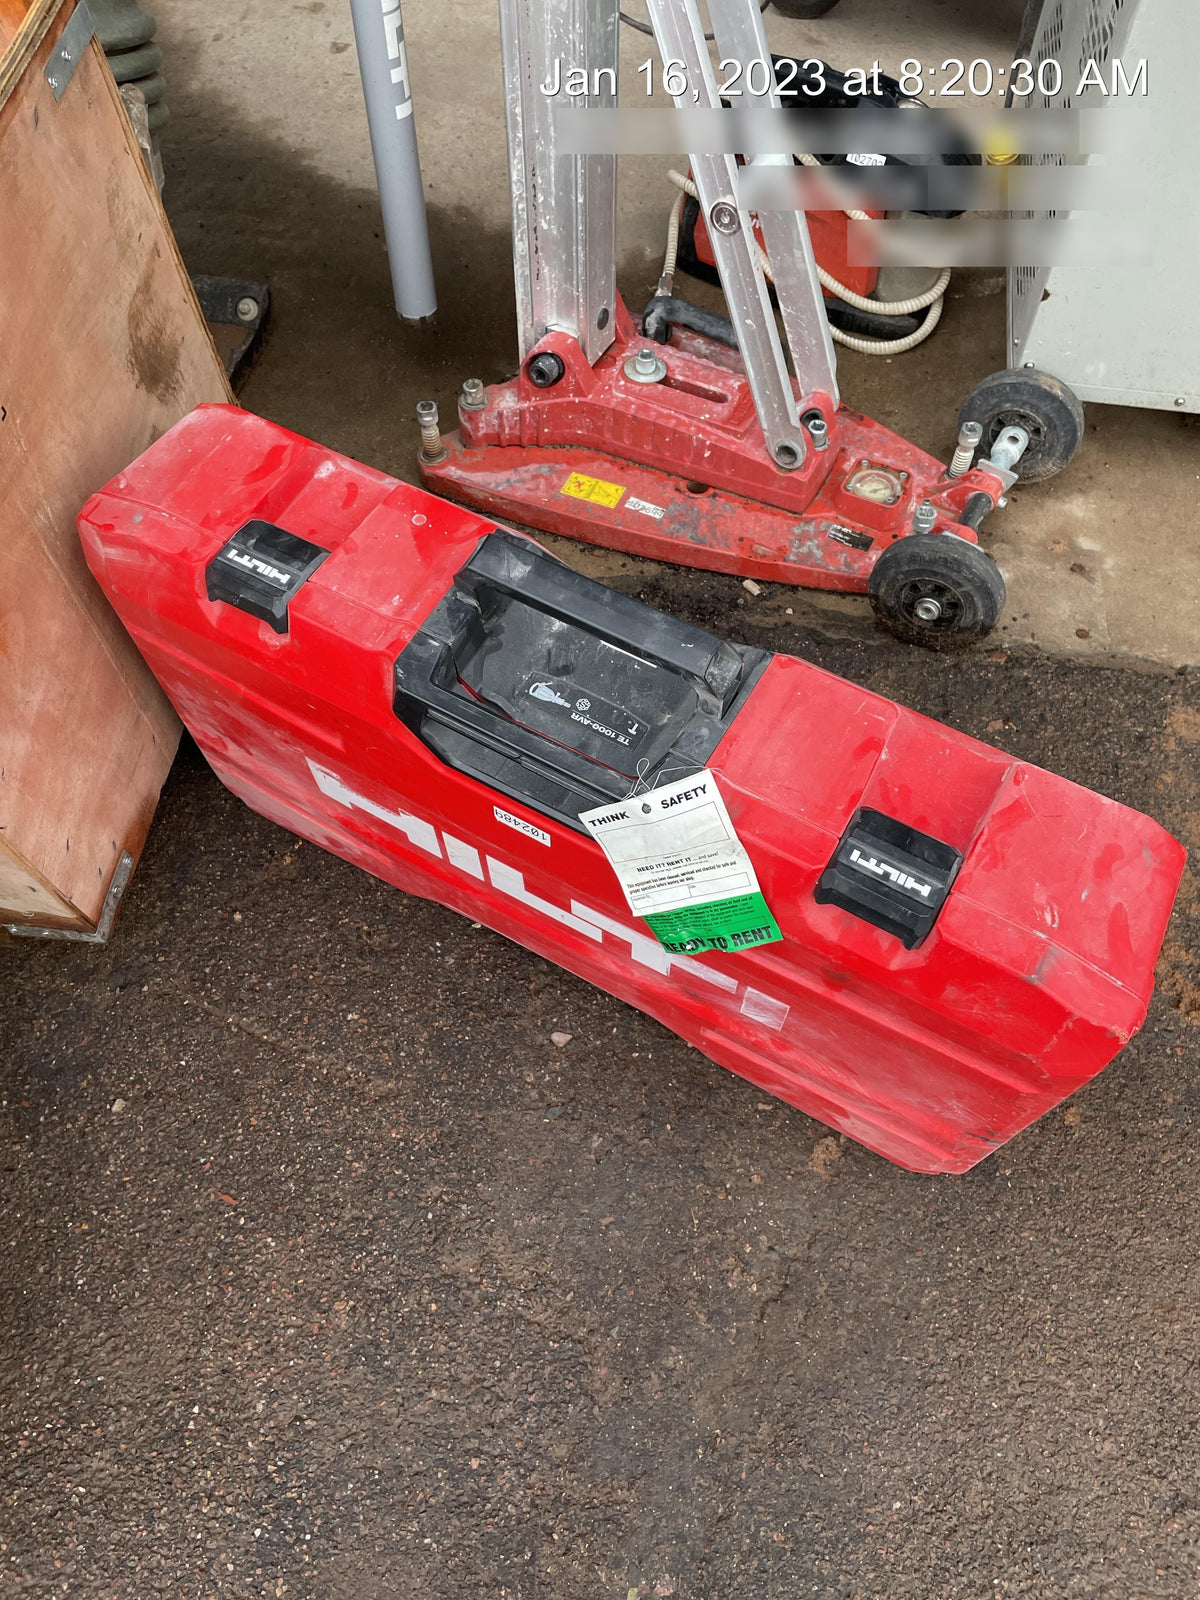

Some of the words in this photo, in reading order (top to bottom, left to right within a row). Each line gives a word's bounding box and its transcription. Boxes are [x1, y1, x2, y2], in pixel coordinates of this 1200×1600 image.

[227, 549, 291, 584] HILTI
[570, 712, 616, 739] 1000-AVR
[616, 734, 630, 746] TE
[588, 811, 630, 827] THINK
[660, 784, 707, 809] SAFETY
[495, 809, 548, 841] 102489
[636, 865, 655, 873] NEED
[666, 859, 684, 867] RENT
[849, 848, 932, 898] HILTI
[305, 755, 790, 1031] HILTI
[707, 936, 729, 950] TO
[730, 925, 773, 947] RENT
